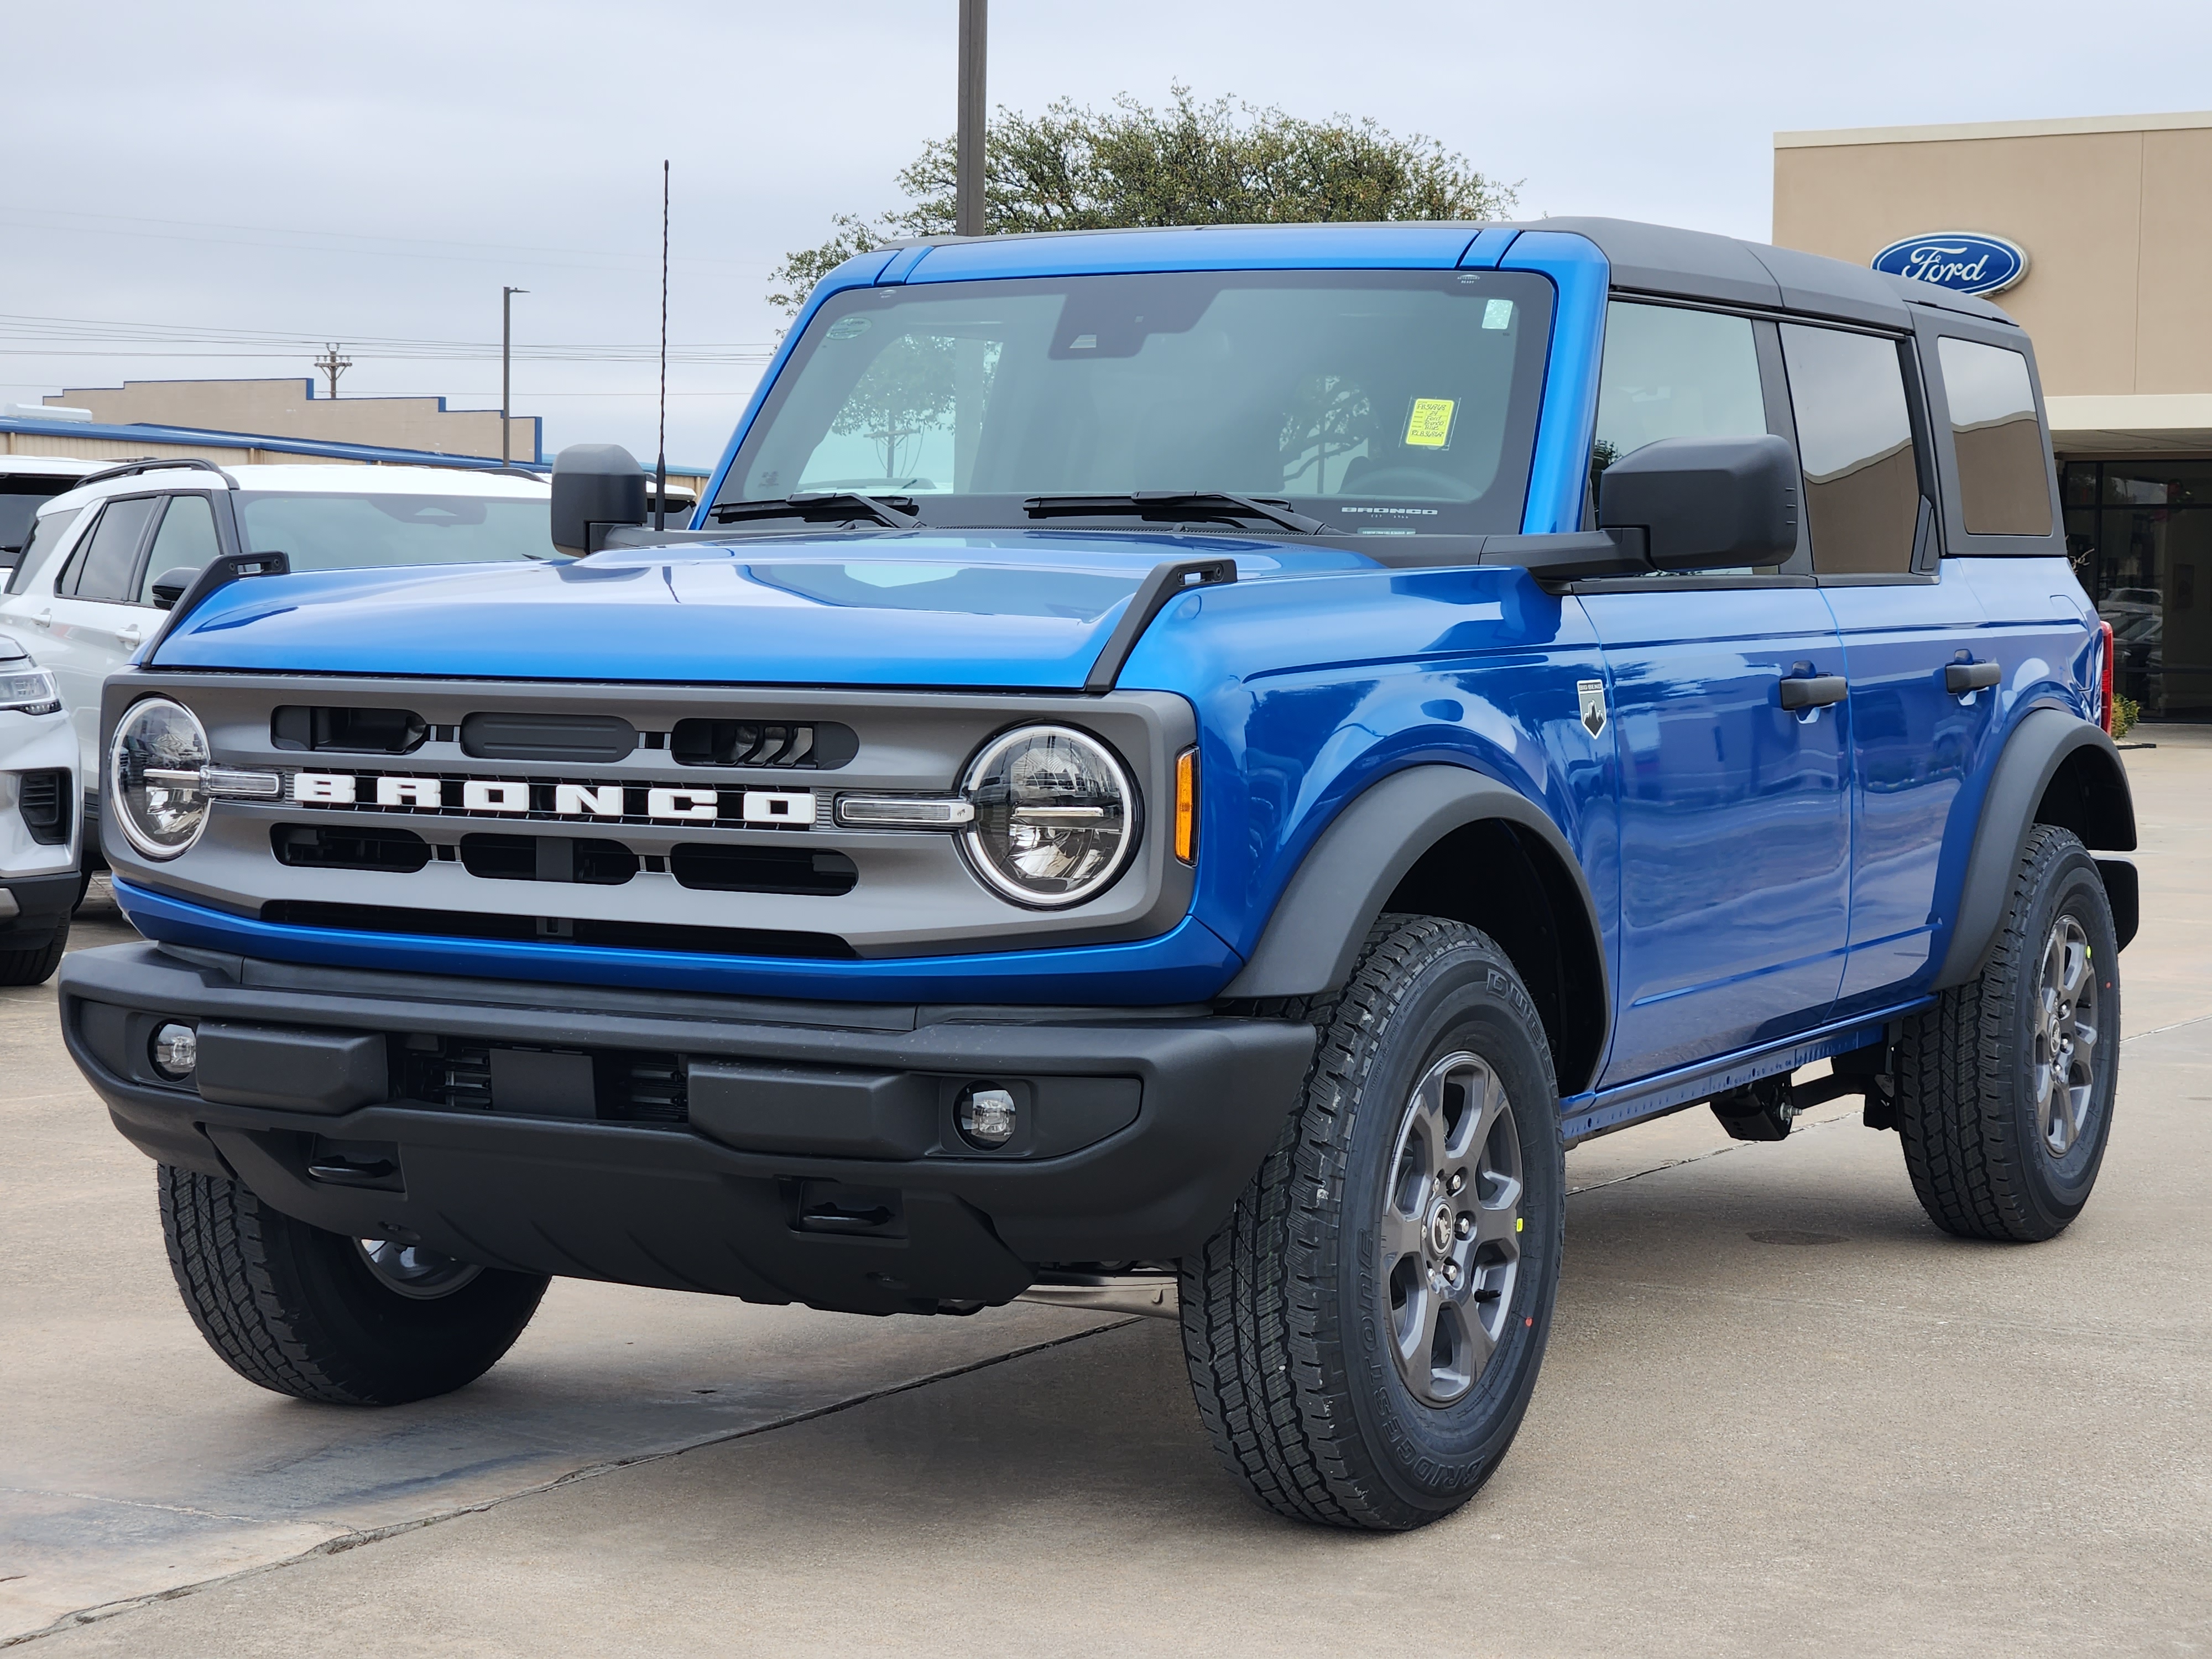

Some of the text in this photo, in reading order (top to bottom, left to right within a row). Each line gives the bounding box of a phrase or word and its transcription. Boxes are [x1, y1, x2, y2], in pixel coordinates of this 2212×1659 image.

[1901, 247, 1989, 282] Ford
[294, 773, 816, 825] BRONCO
[1357, 1228, 1486, 1489] BRIDGESTONE
